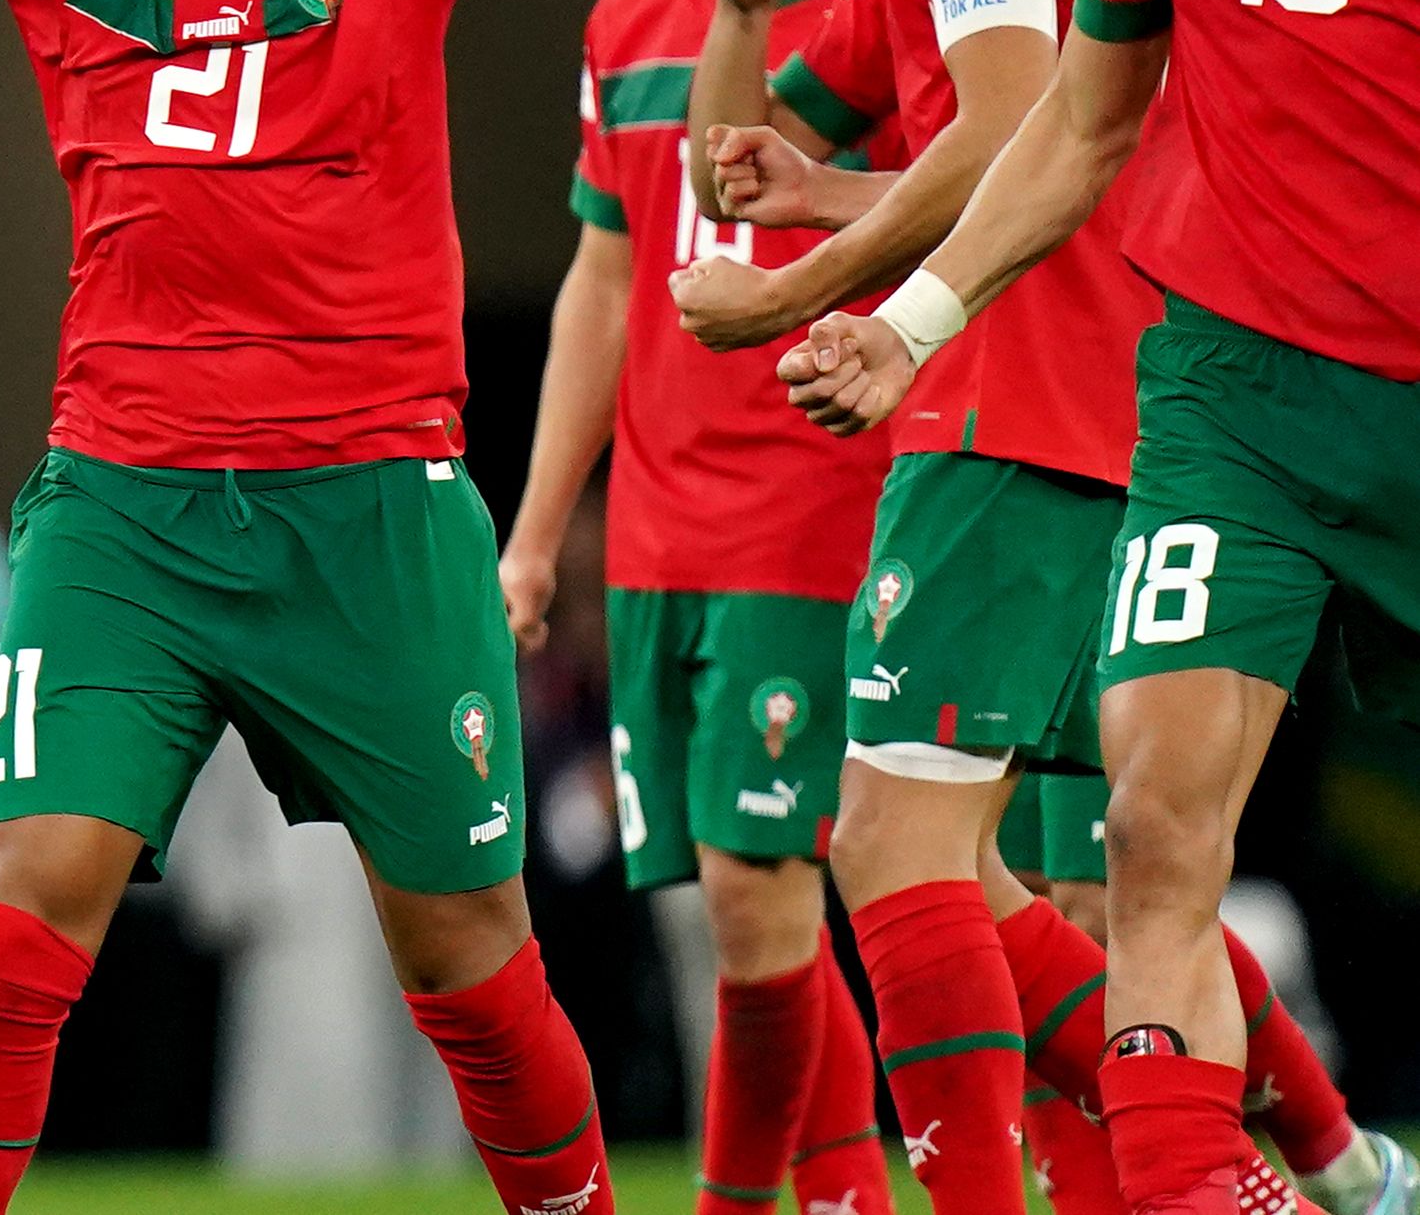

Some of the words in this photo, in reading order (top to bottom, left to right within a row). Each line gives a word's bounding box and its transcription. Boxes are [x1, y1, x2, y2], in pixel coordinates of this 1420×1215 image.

[181, 16, 240, 40] PUMA
[144, 40, 270, 158] 21
[1108, 523, 1220, 658] 18
[469, 814, 508, 846] PUMA
